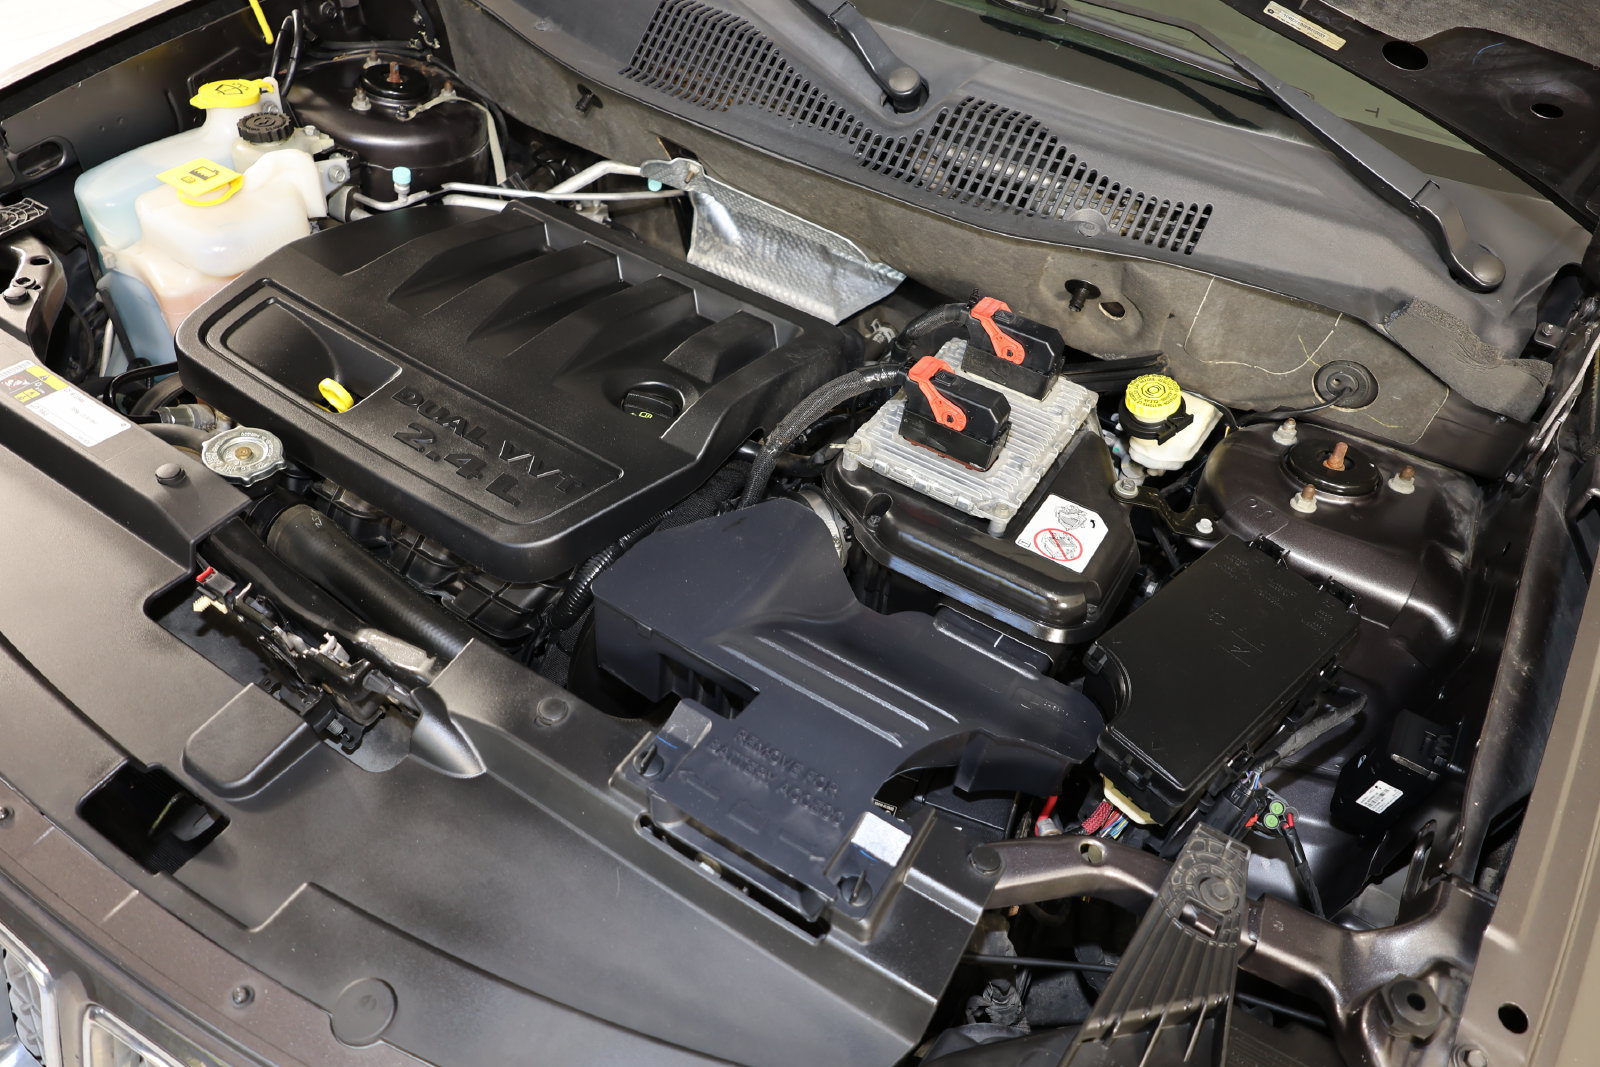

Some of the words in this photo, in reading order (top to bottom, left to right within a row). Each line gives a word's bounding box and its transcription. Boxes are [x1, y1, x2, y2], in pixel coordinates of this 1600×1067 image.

[392, 386, 488, 449] DUAL
[499, 440, 584, 493] VVT
[393, 422, 487, 479] 2.4
[485, 472, 521, 507] L
[709, 739, 774, 788] BATTERY
[776, 784, 844, 828] ACCESS
[734, 729, 803, 778] REMOVE
[803, 770, 838, 799] FOR
